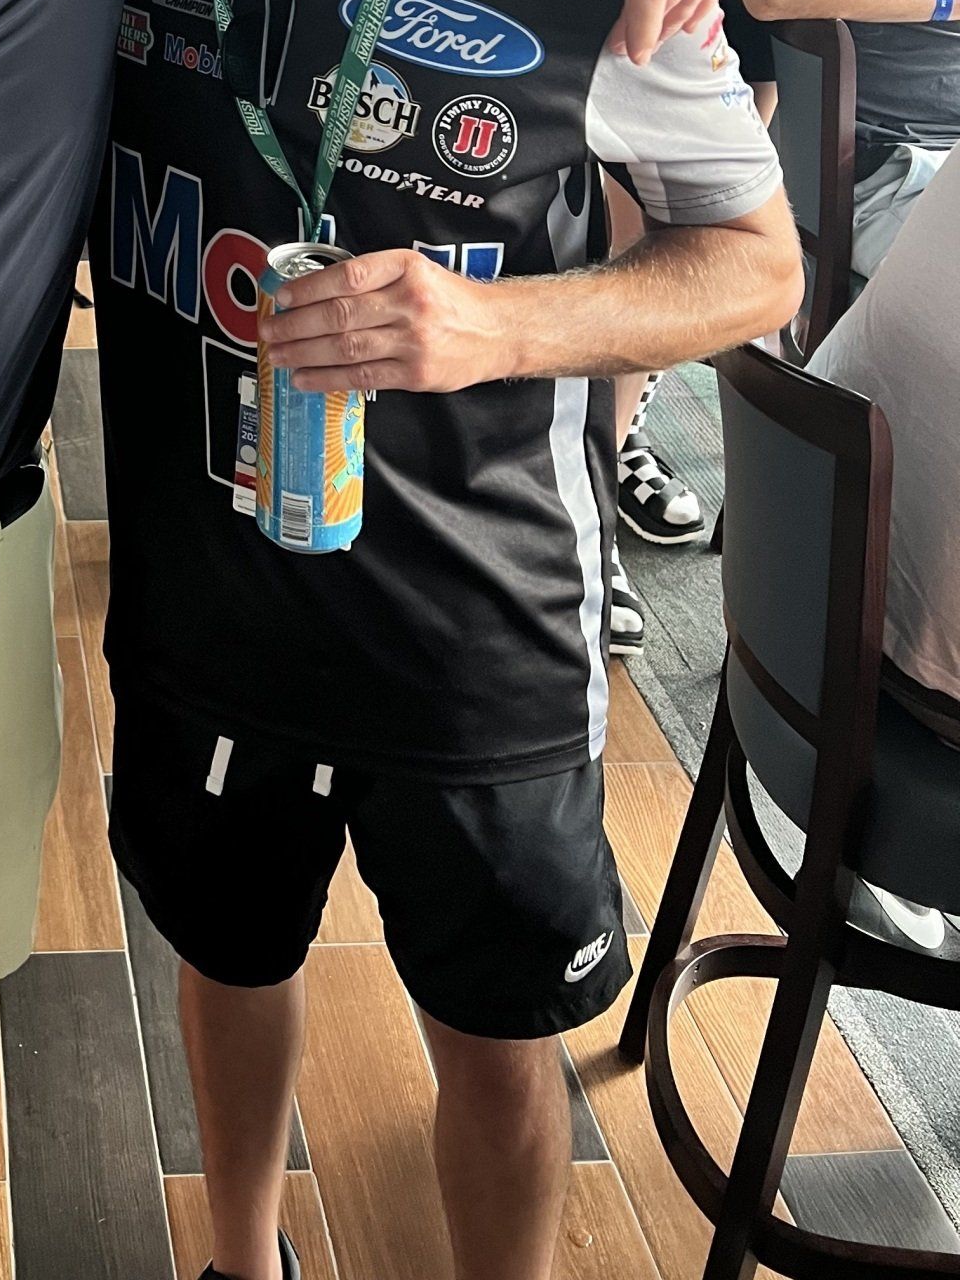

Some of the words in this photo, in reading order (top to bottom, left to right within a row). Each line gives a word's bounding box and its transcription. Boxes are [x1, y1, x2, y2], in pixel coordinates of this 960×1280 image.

[163, 32, 223, 81] Mobi
[356, 13, 382, 65] FENWAY
[309, 79, 419, 136] BSCH
[326, 94, 341, 139] RACING
[338, 79, 360, 126] ROUSH
[439, 100, 482, 131] JIMMY
[483, 102, 512, 144] JOHN'S
[326, 121, 348, 173] FENWAY
[352, 119, 375, 132] EER
[452, 114, 499, 159] JJ
[438, 133, 464, 168] GOURMET
[463, 148, 509, 172] SANDWICHES
[572, 932, 607, 969] NIKE
